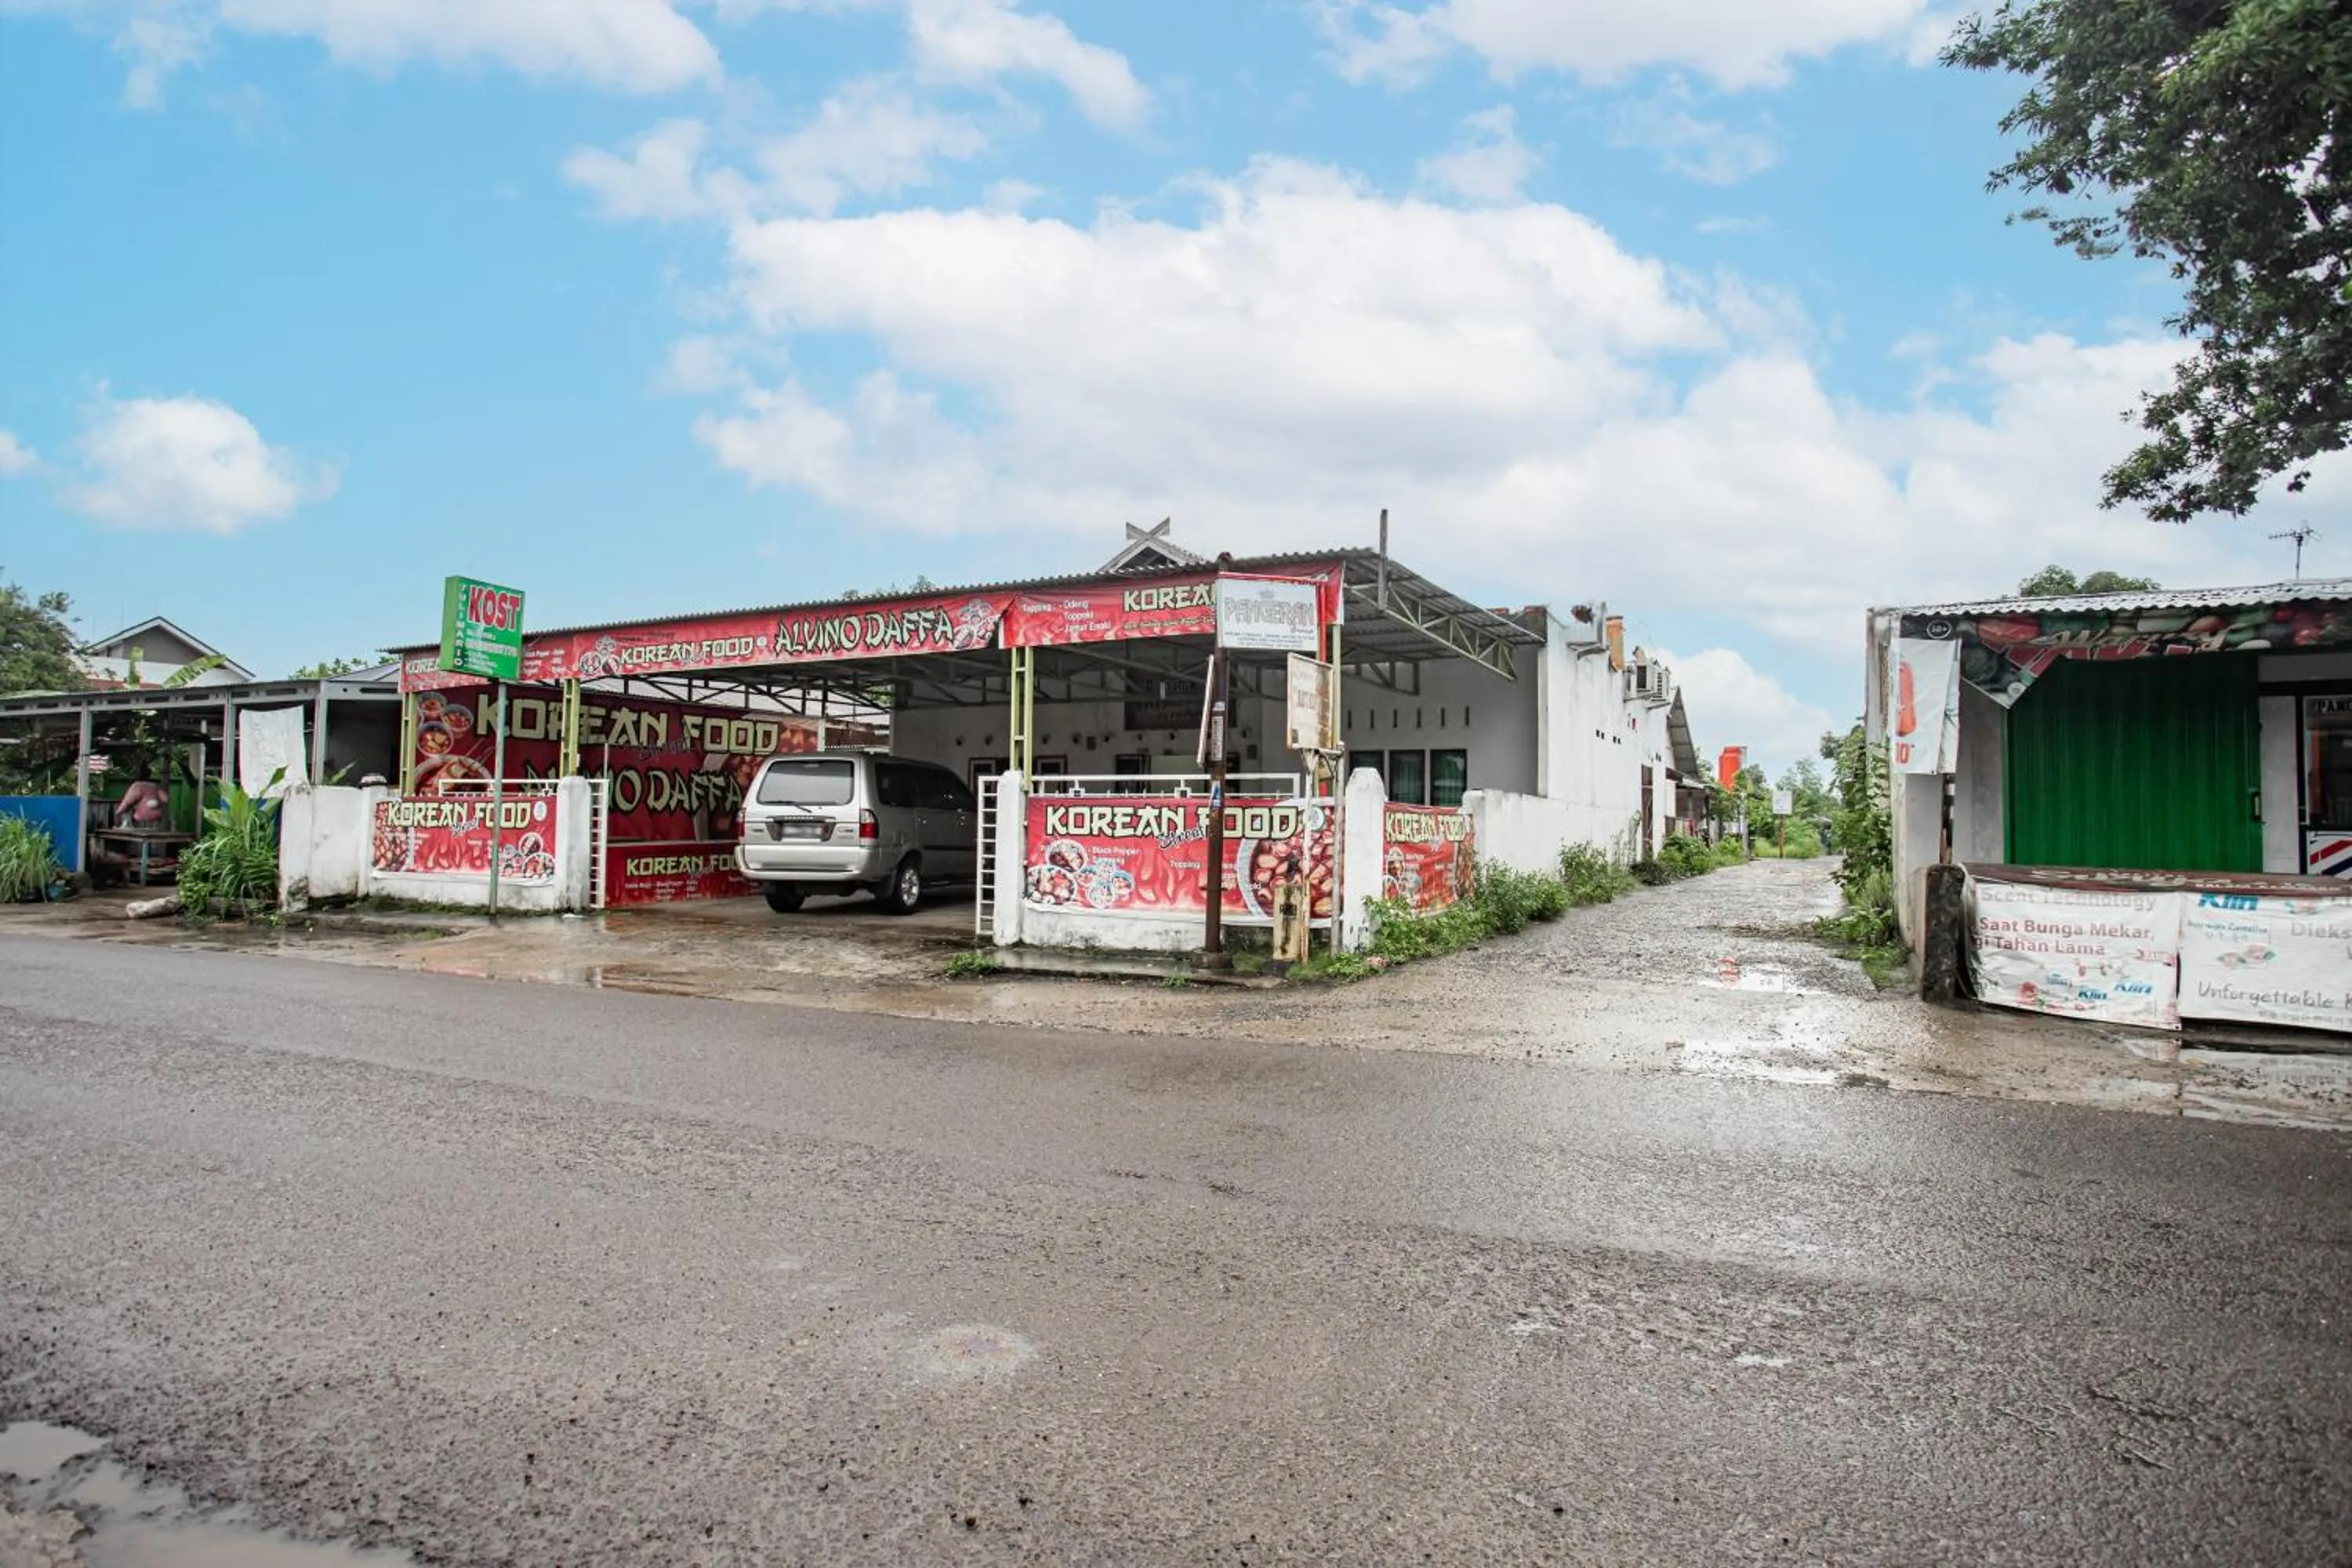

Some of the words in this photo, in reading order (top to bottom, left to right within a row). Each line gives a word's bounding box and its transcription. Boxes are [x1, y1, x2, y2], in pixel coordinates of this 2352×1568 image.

[467, 585, 521, 632] KOST
[1123, 583, 1217, 612] KOREA
[775, 615, 862, 655] ALVINO
[865, 605, 954, 649] DAFFA
[621, 642, 696, 665] KOREAN
[702, 637, 754, 658] FOOD
[475, 693, 668, 748] KOREAN
[682, 715, 779, 755] FOOD
[647, 768, 743, 815] DAFFA
[387, 801, 468, 828] KOREAN
[1046, 804, 1185, 837] KOREAN
[1385, 811, 1436, 843] KOREAN
[626, 855, 703, 876] KOREAN
[710, 853, 740, 871] FOO
[1980, 917, 2018, 931] Saat
[2024, 920, 2083, 938] Bunga
[2090, 923, 2154, 941] Mekar,
[1996, 937, 2049, 953] Tahan
[2055, 940, 2106, 956] Lama
[2198, 980, 2334, 1009] Unforgettable
